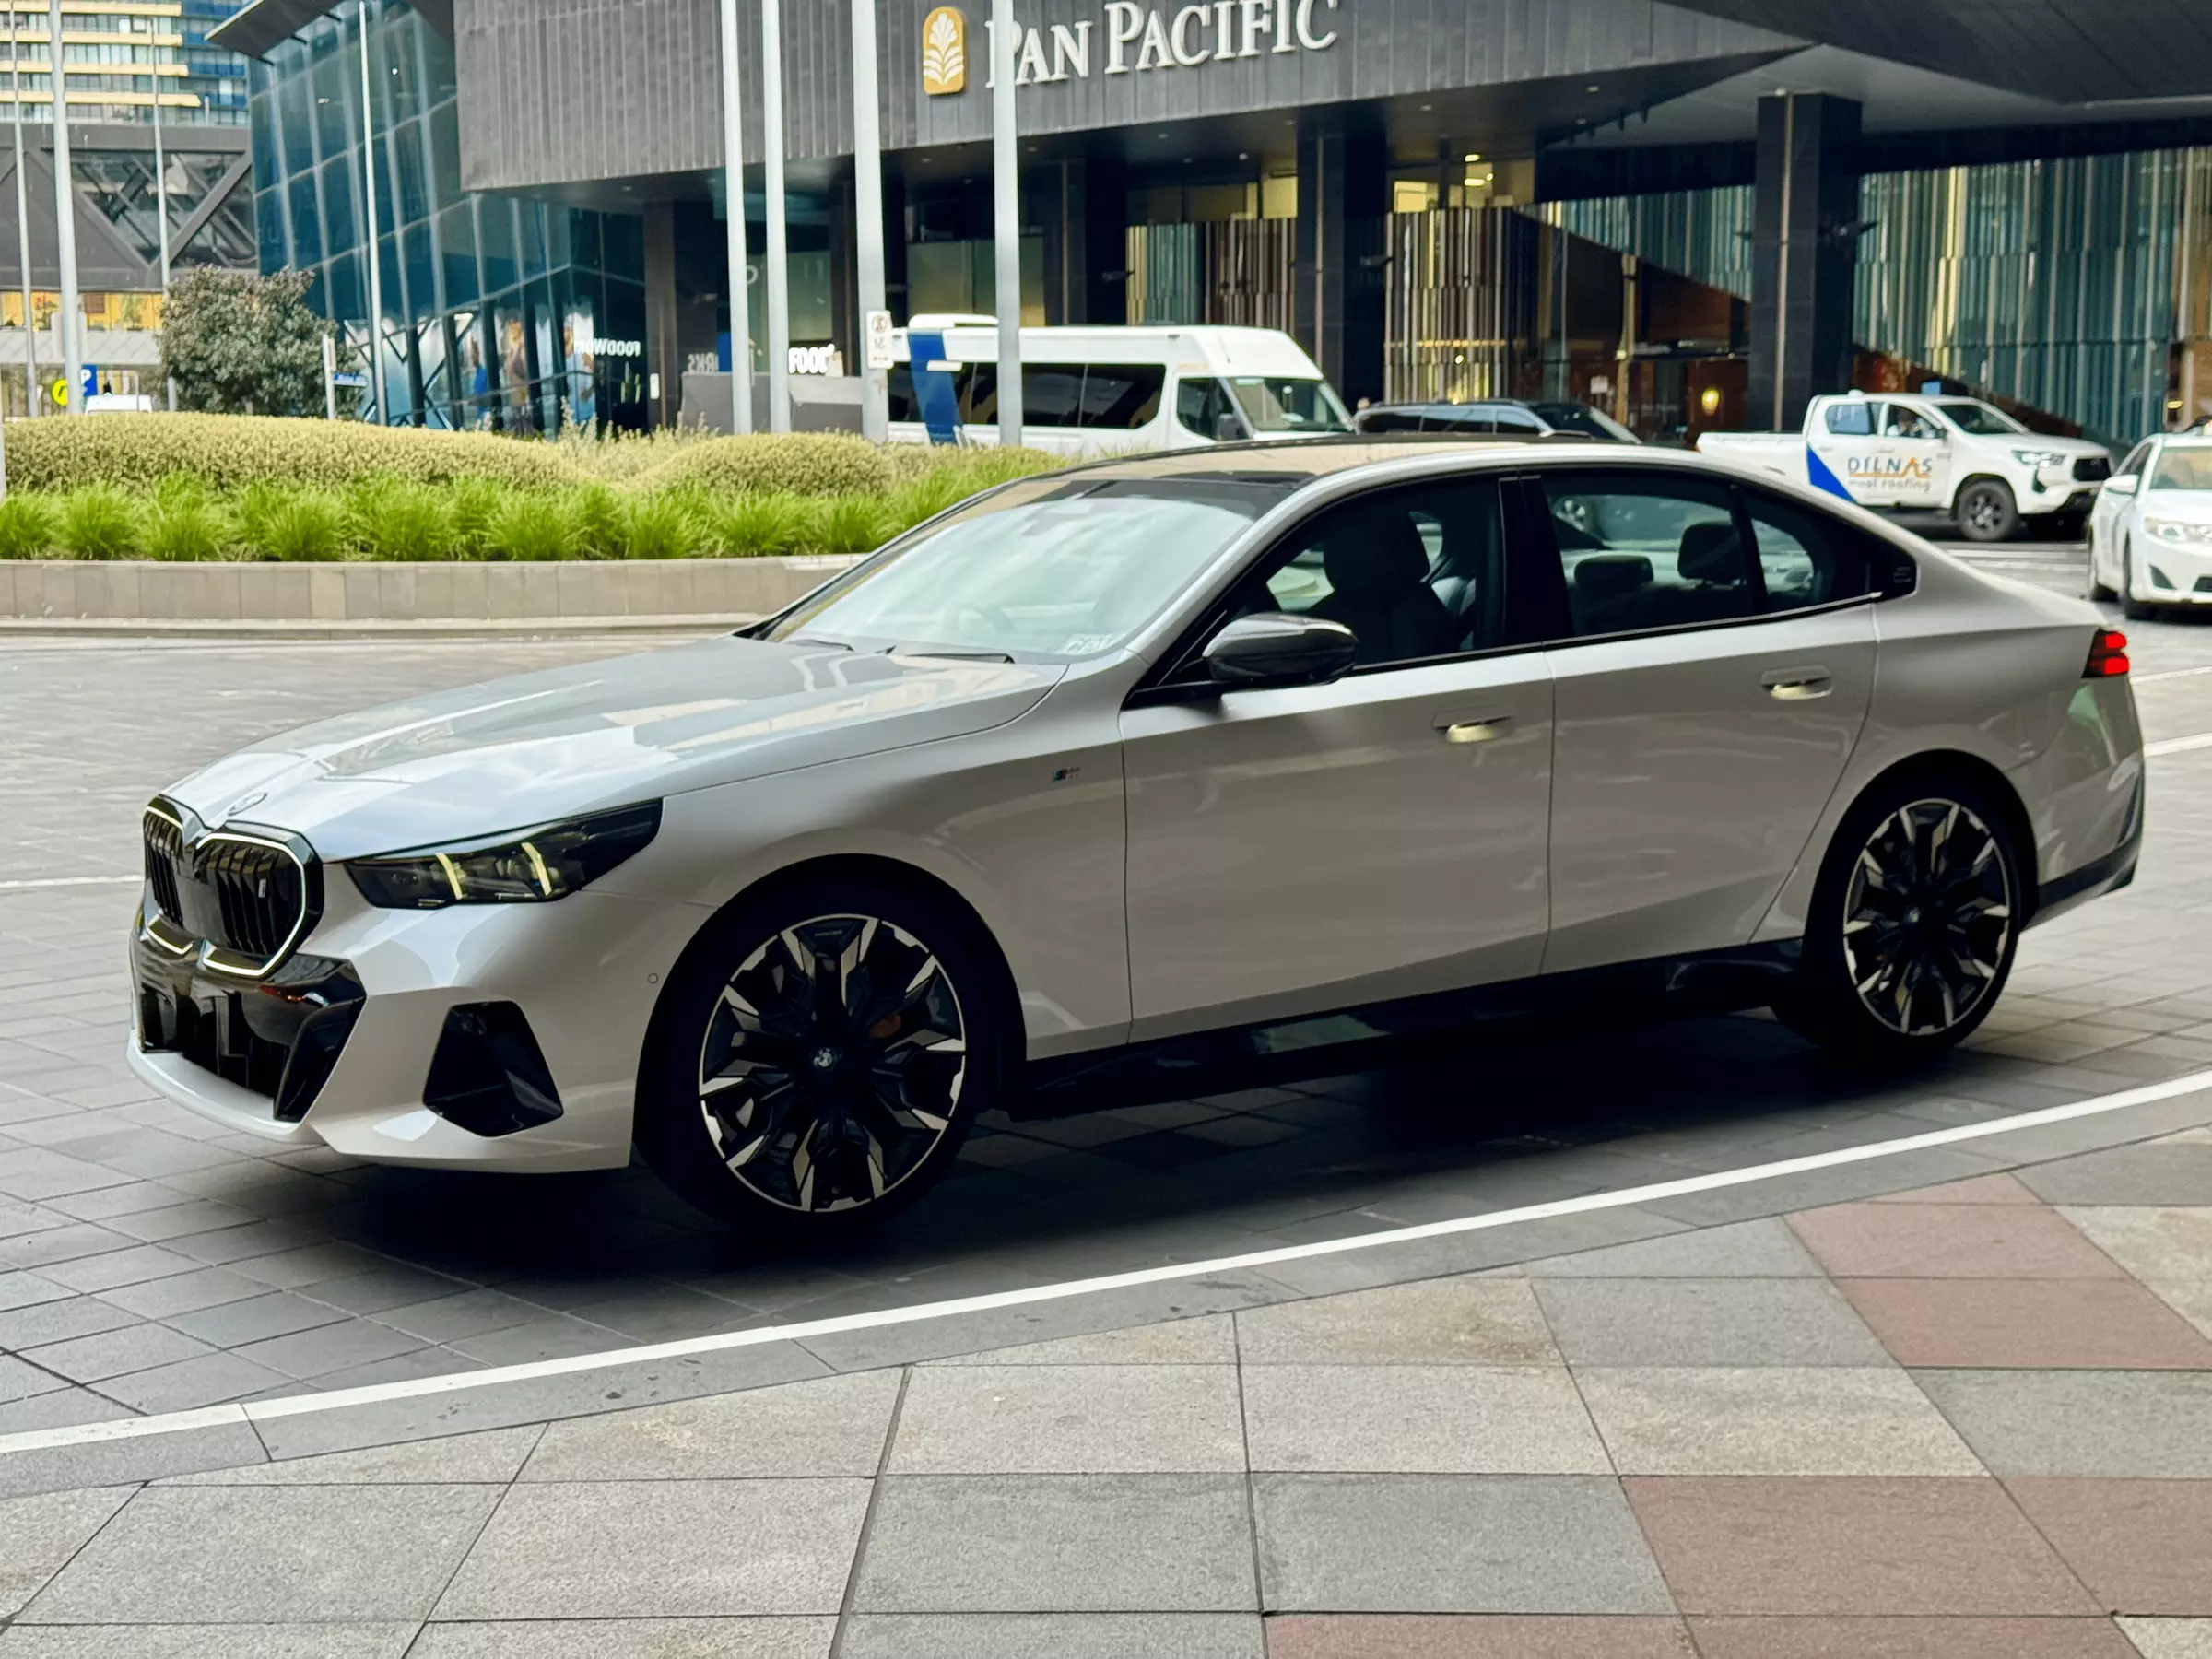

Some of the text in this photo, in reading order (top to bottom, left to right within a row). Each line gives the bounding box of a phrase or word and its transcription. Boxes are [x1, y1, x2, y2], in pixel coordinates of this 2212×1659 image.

[984, 0, 1338, 88] PAN PACIFIC
[1847, 456, 1933, 477] DILNAS
